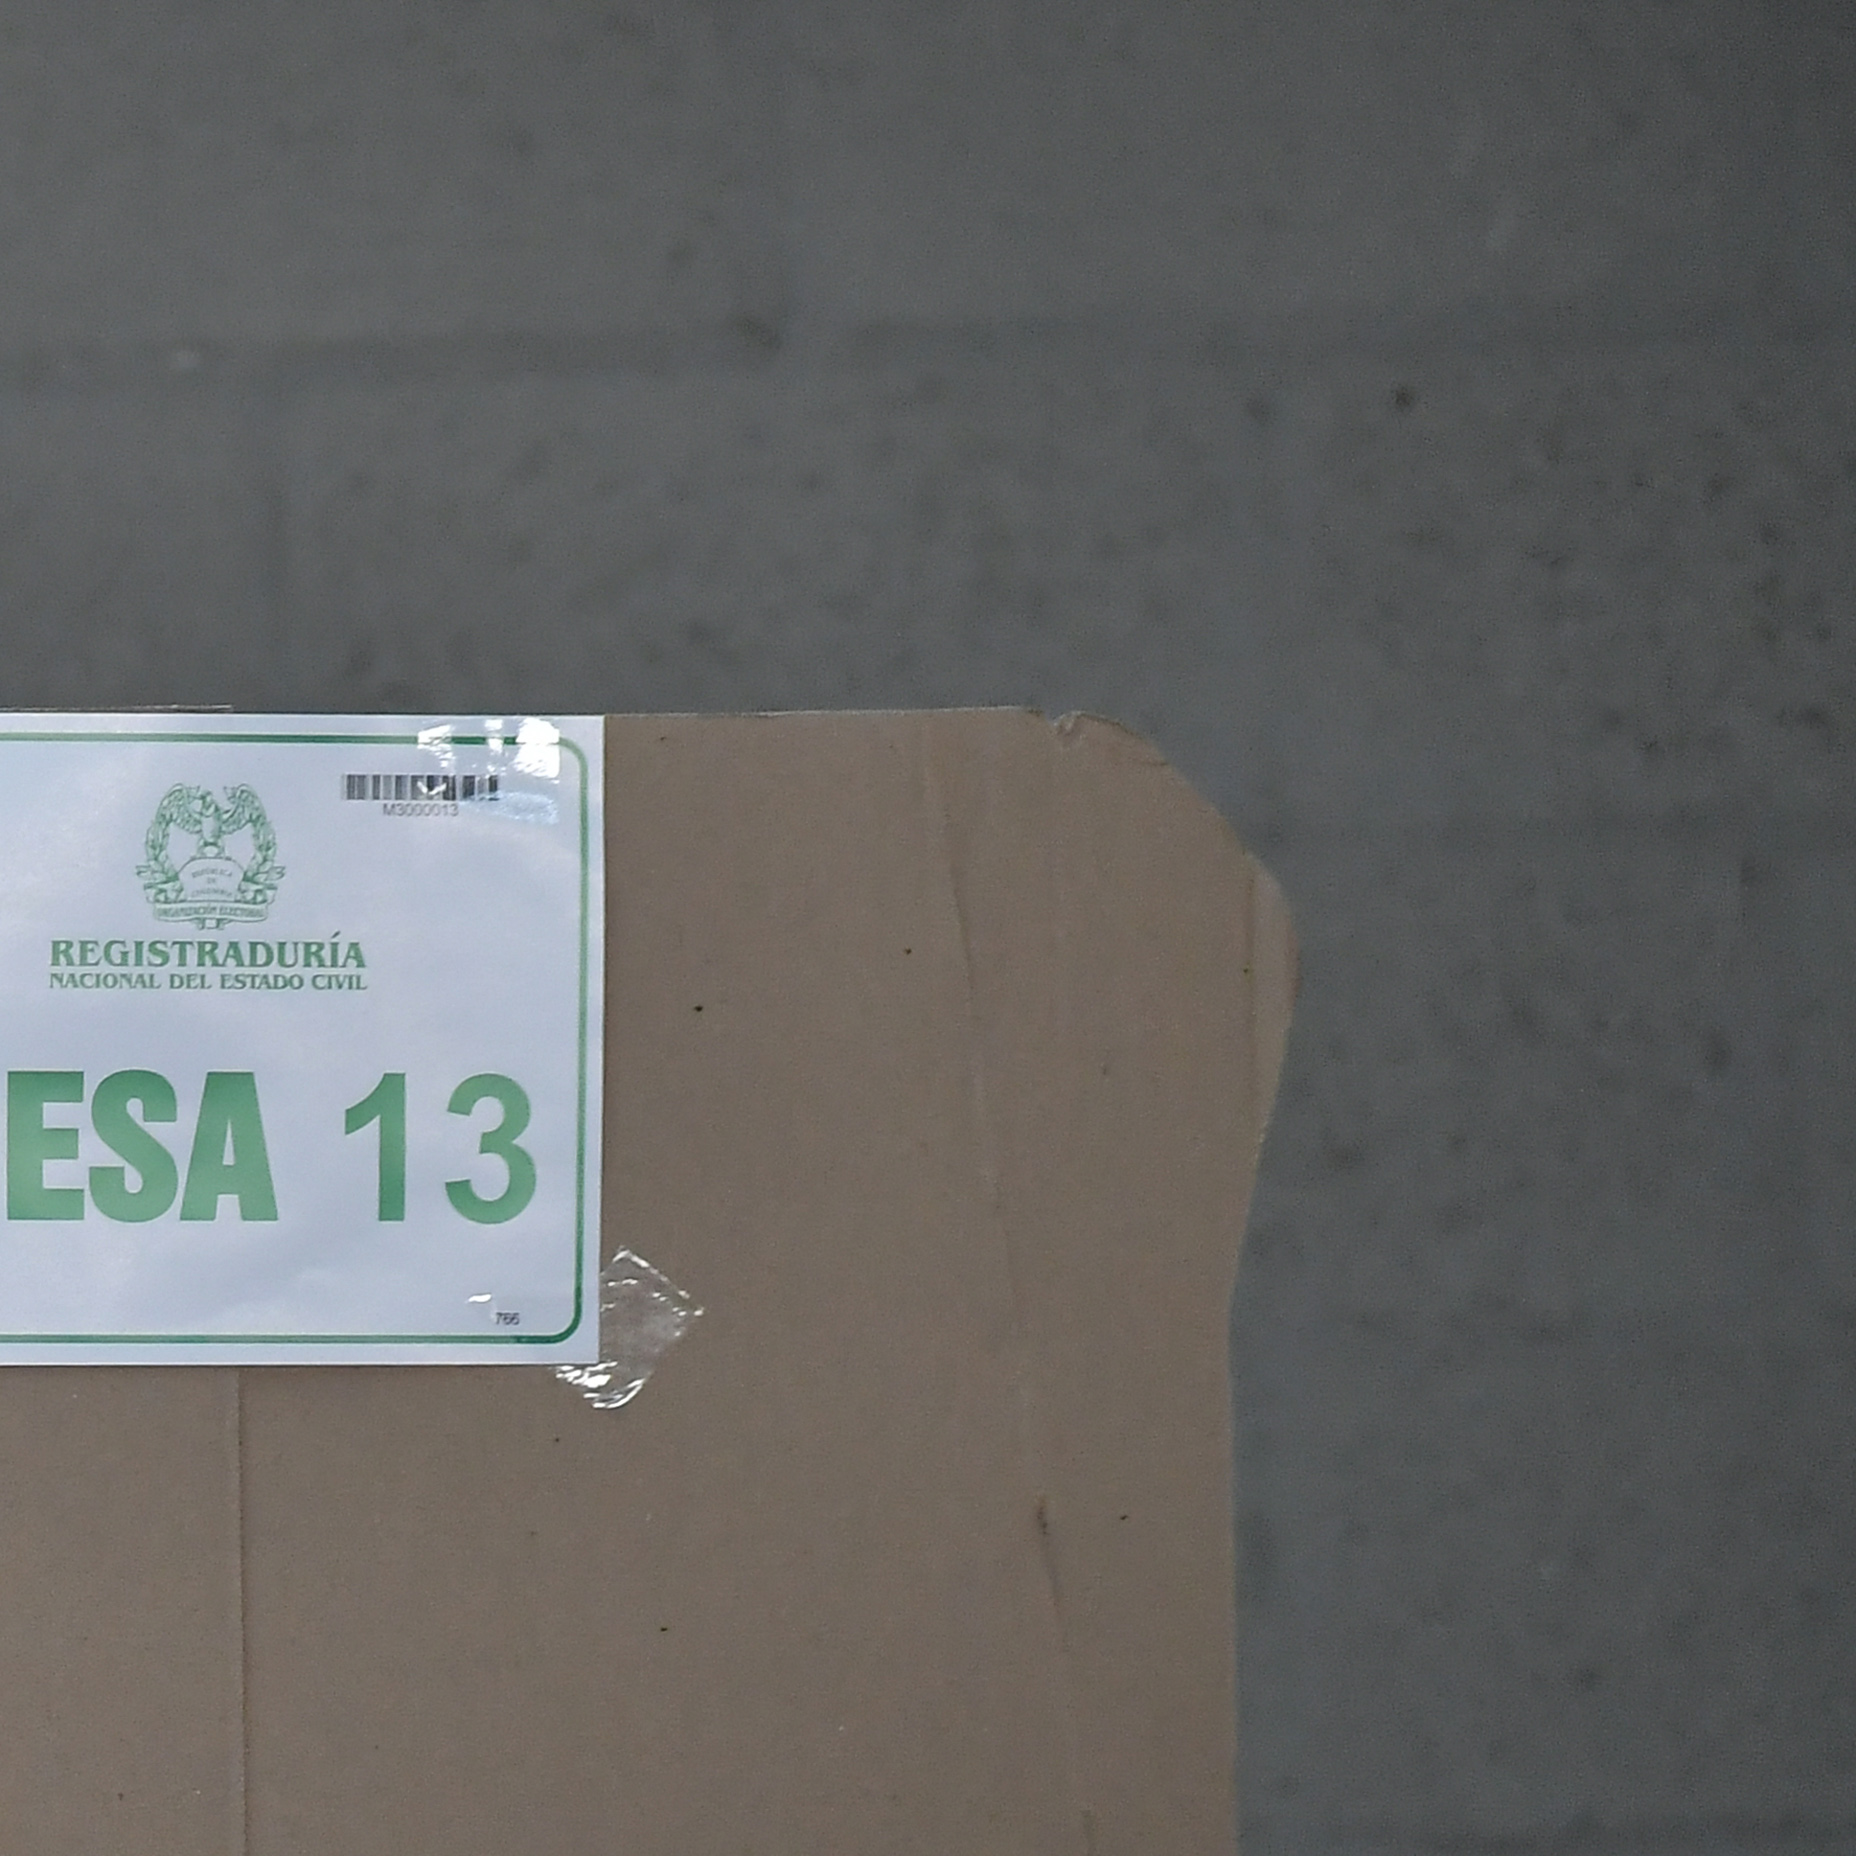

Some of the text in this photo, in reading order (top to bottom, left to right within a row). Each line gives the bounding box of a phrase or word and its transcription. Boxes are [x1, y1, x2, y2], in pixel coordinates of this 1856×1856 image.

[50, 930, 367, 968] REGISTRADURÍA
[49, 973, 368, 991] NACIONAL DEL ESTADO CIVIL
[343, 1072, 538, 1225] 13
